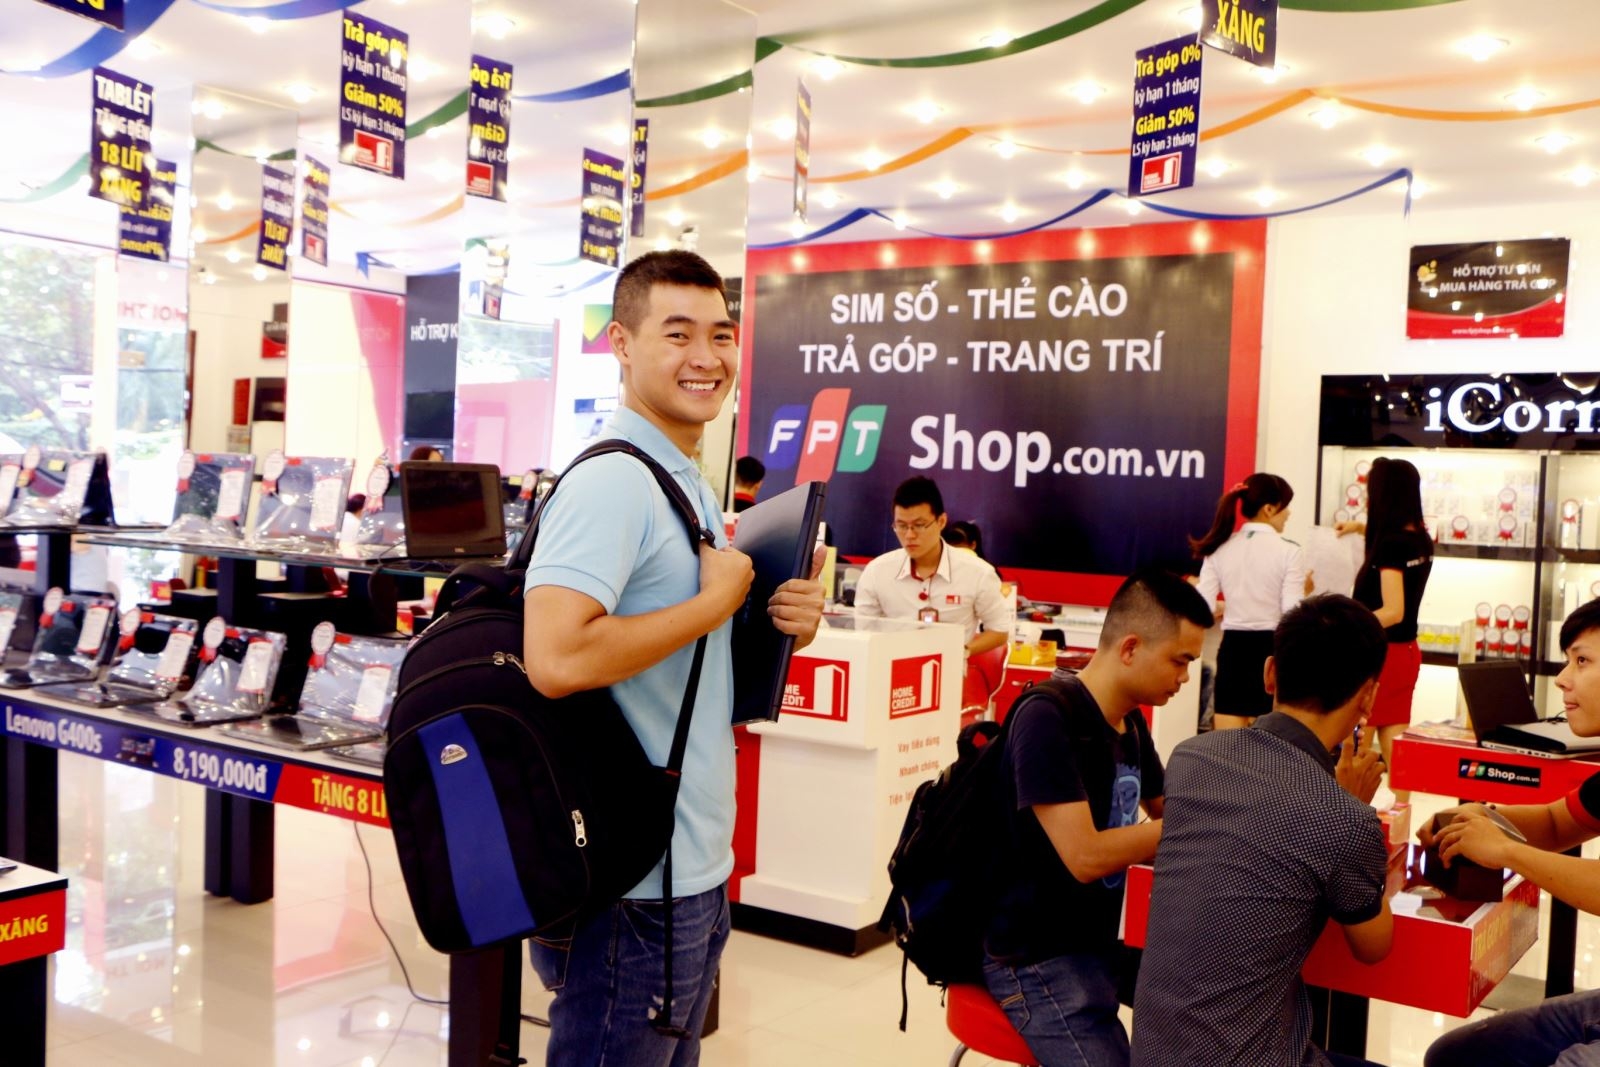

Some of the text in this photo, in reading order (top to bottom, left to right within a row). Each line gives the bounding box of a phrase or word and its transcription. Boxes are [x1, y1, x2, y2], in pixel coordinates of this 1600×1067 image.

[343, 18, 365, 45] Trả
[365, 31, 390, 56] góp
[1215, 0, 1266, 53] XĂNG
[356, 53, 374, 77] hạn
[375, 63, 381, 79] 1
[1136, 44, 1201, 78] Trả góp 0%
[344, 81, 404, 118] Giảm 50%
[1134, 77, 1200, 108] kỳ hạn 1 tháng
[341, 105, 352, 122] LS
[377, 116, 384, 131] 3
[1136, 105, 1195, 136] Giảm 50%
[99, 140, 144, 174] 18 LÍT
[1132, 141, 1141, 157] LS
[1151, 139, 1165, 154] hạn
[1166, 136, 1171, 149] 3
[1172, 132, 1196, 147] tháng
[830, 292, 884, 324] SIM
[893, 280, 939, 323] SỐ
[967, 276, 1037, 320] THẺ
[1047, 278, 1128, 318] CÀO
[1439, 281, 1466, 292] MUA
[1468, 278, 1502, 291] HÀNG
[1530, 278, 1557, 290] GP
[799, 334, 861, 374] TRẢ
[868, 337, 937, 373] GÓP
[967, 340, 1091, 373] TRANG
[1102, 331, 1166, 372] TRÍ
[768, 413, 1206, 488] FPT Shop.com.vn
[891, 696, 917, 710] CREDIT
[892, 685, 914, 699] HOME
[6, 705, 56, 742] Lenovo
[58, 718, 103, 754] G400s
[173, 747, 268, 794] 8,190,000đ
[311, 774, 354, 813] TẶNG
[357, 788, 369, 814] 8
[0, 914, 48, 943] XĂNG
